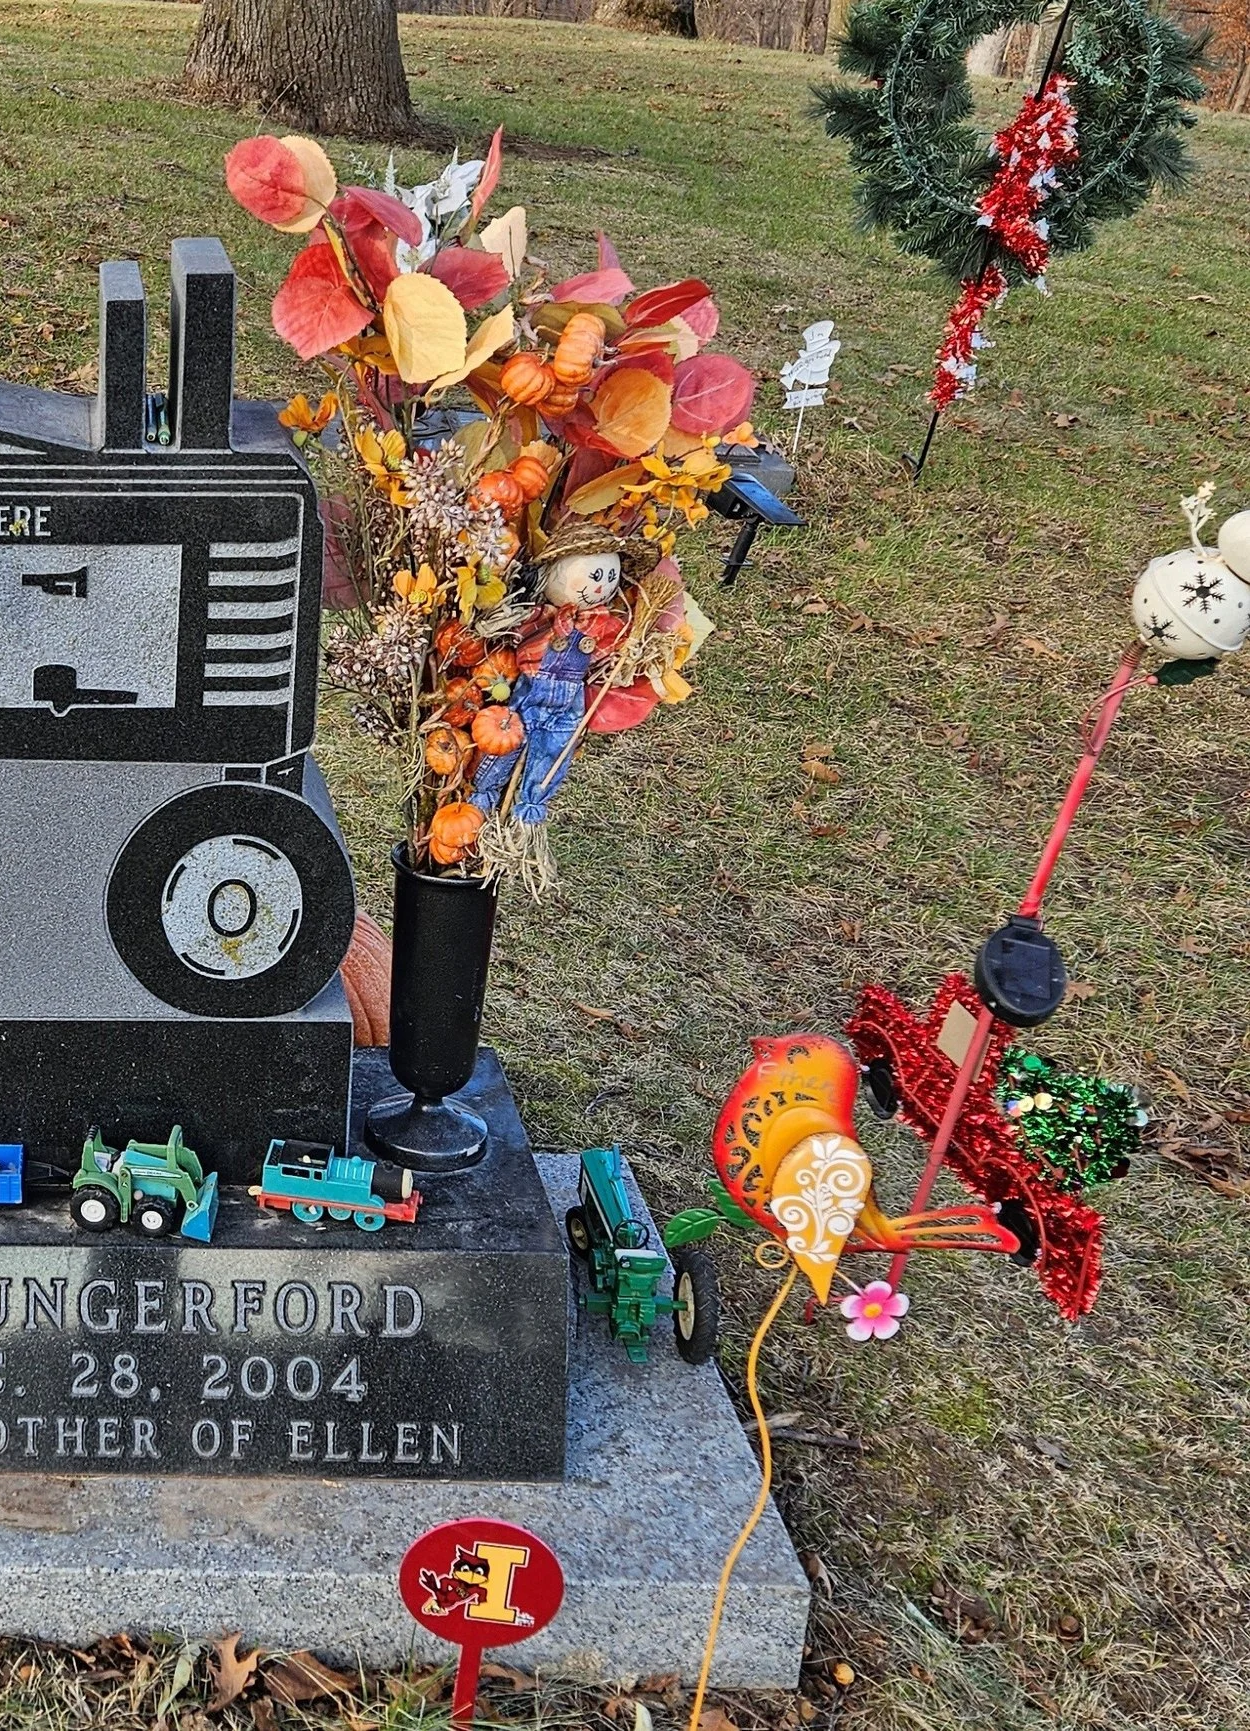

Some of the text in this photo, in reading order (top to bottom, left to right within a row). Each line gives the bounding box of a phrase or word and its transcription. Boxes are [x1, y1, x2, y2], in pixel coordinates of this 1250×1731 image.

[70, 1351, 161, 1402] 28,
[201, 1353, 368, 1402] 2004
[191, 1418, 253, 1460] OF
[288, 1419, 462, 1465] ELLEN
